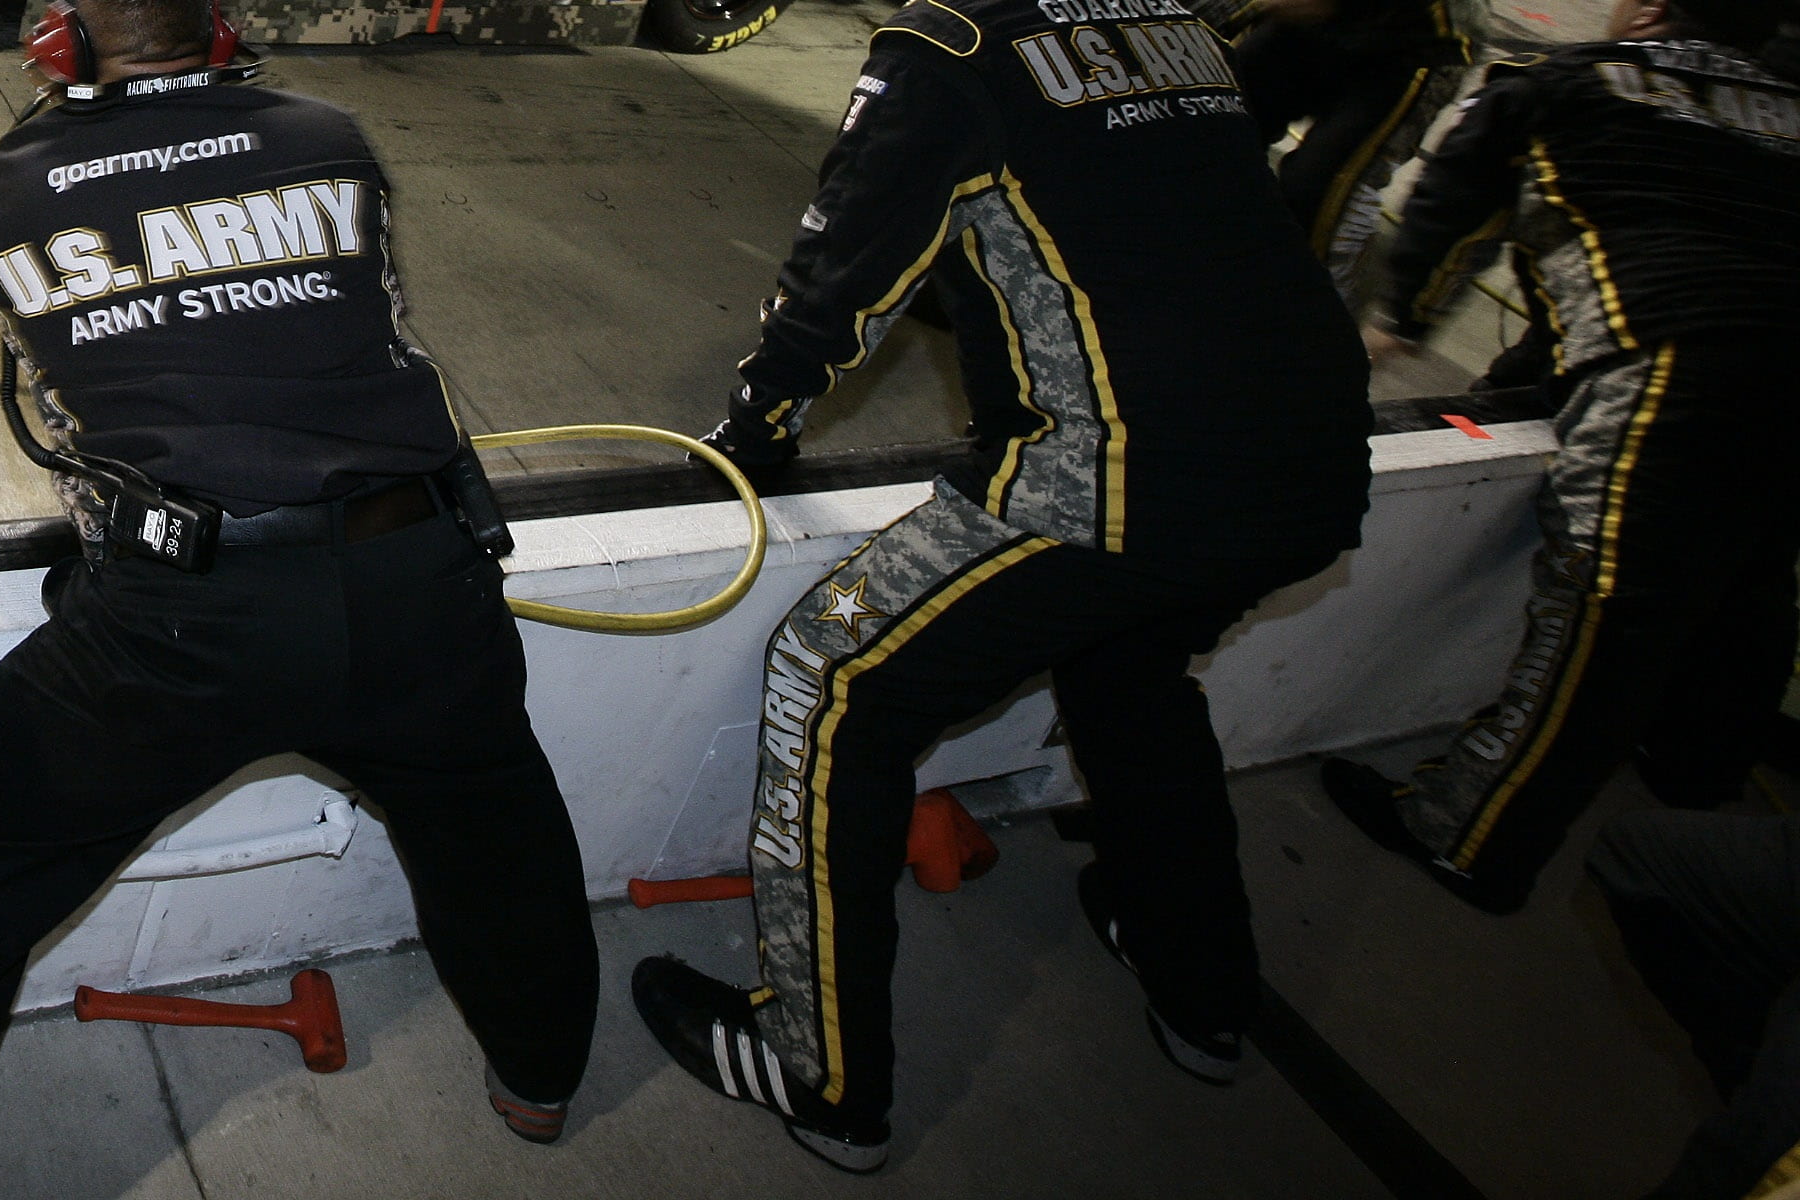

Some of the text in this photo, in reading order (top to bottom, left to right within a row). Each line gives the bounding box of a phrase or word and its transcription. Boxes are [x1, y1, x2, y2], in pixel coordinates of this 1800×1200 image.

[708, 5, 777, 52] EAGLE
[126, 80, 154, 97] RACING
[1011, 24, 1153, 109] U.S.
[1106, 98, 1175, 130] ARMY
[47, 131, 252, 193] goarmy.com
[137, 178, 364, 284] ARMY
[71, 294, 168, 346] ARMY
[165, 518, 183, 557] 39-24
[753, 619, 828, 870] U.S. ARMY
